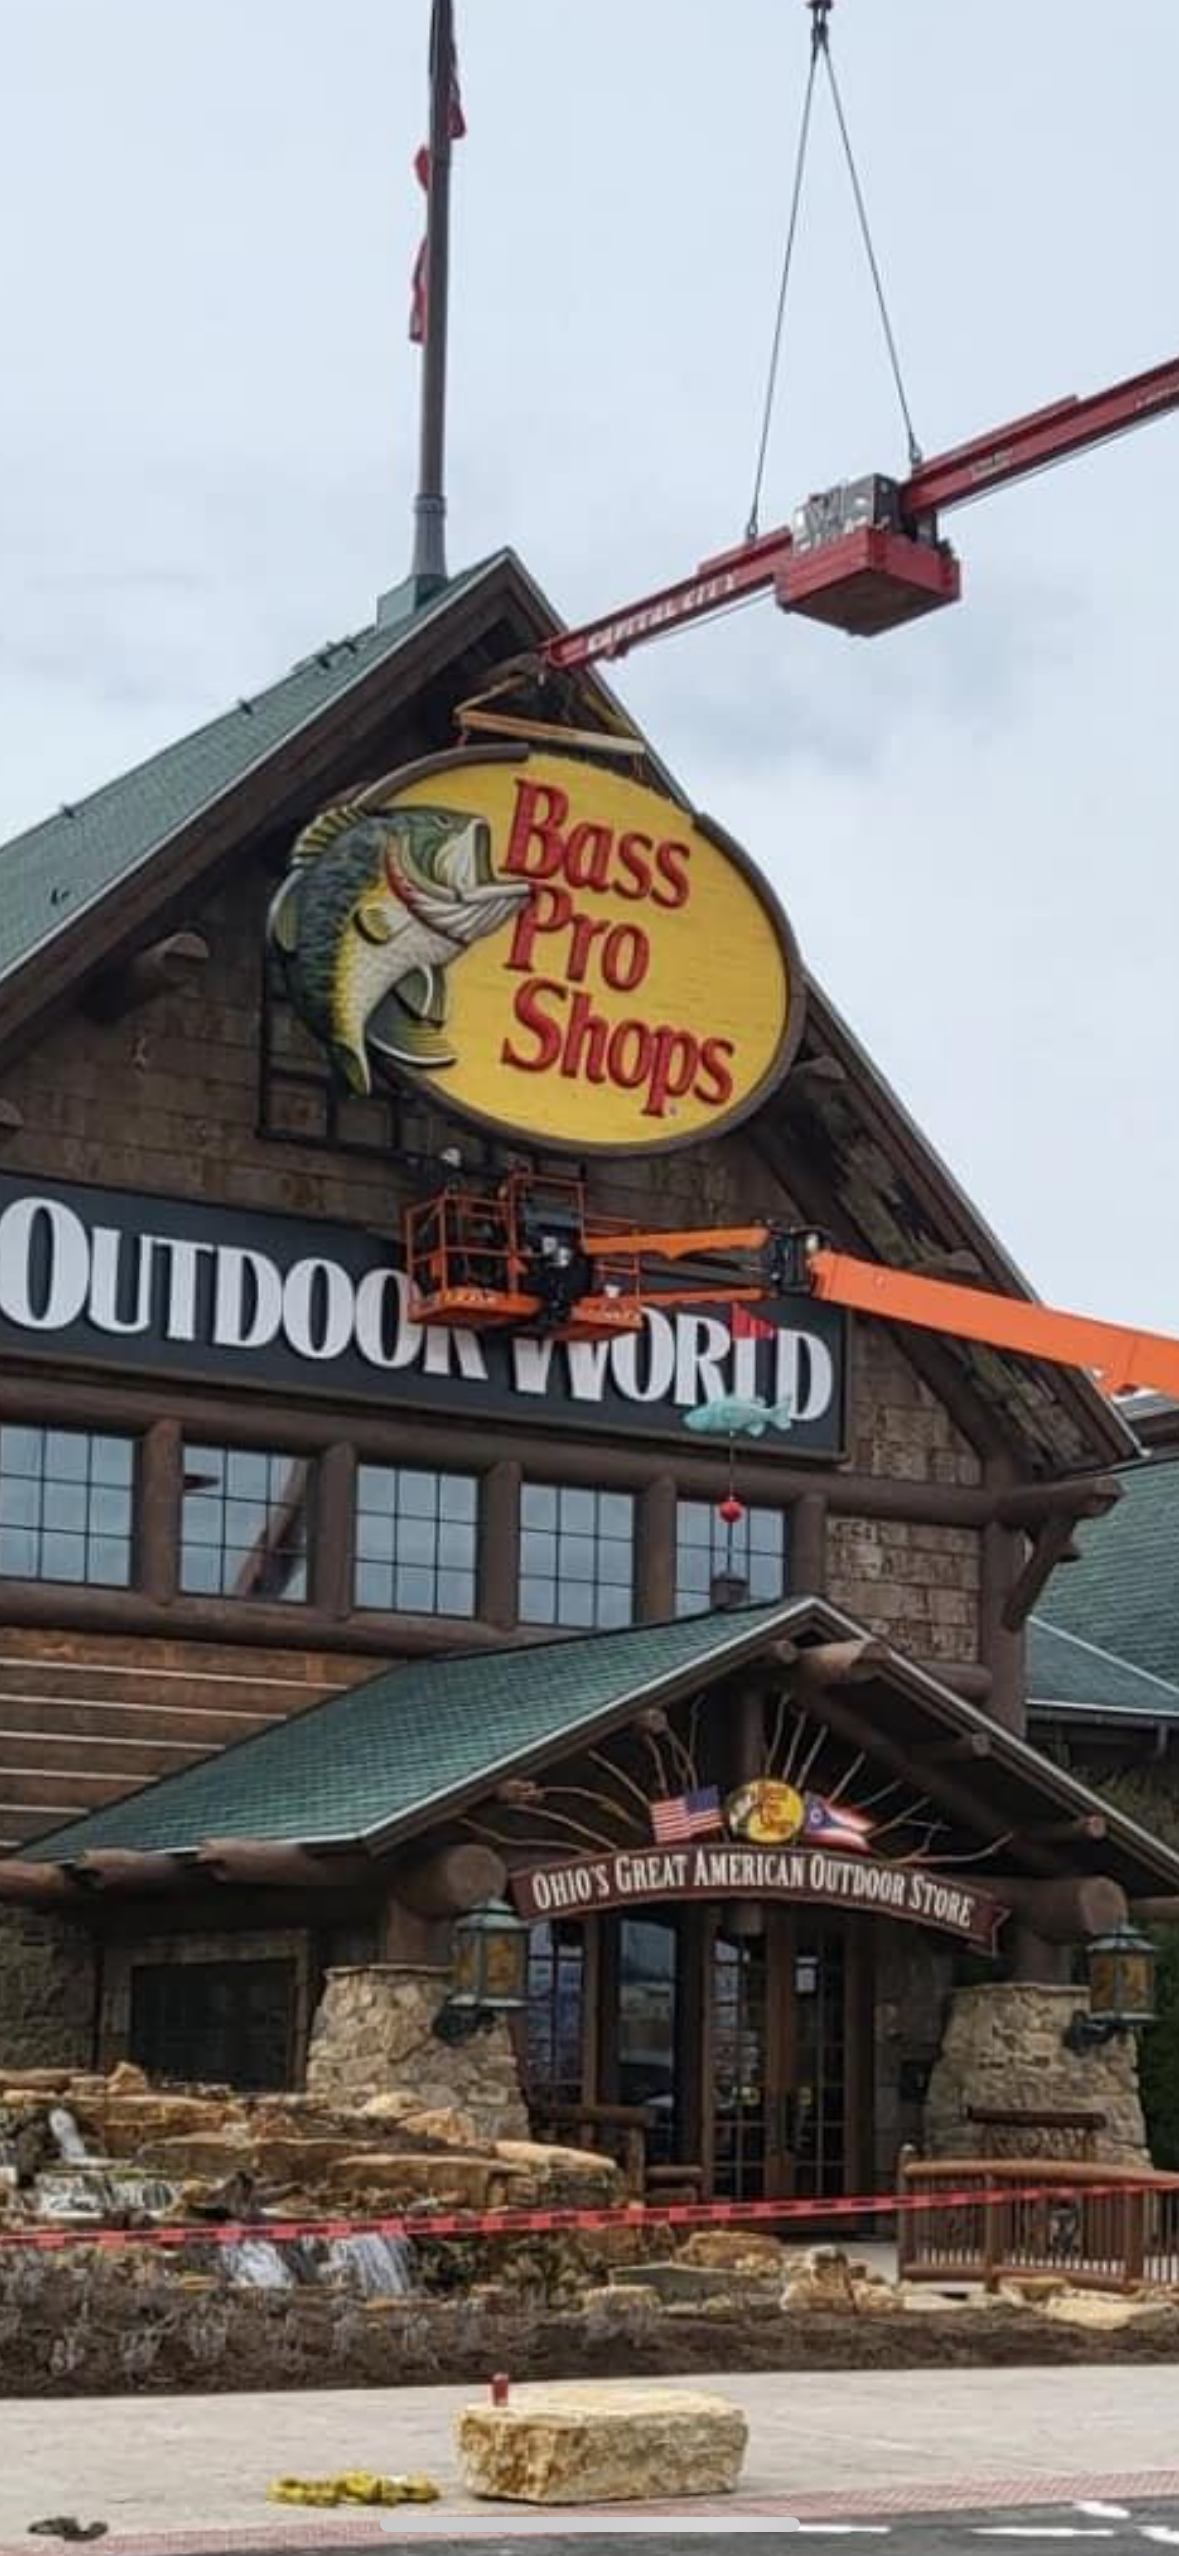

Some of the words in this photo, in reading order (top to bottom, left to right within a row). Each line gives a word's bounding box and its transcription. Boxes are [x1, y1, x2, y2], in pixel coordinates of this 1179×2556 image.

[498, 778, 691, 909] Bass
[503, 881, 651, 992] Pro
[500, 977, 735, 1119] Shops
[532, 1864, 610, 1910] OHIO'S
[615, 1854, 688, 1893] GREAT
[693, 1847, 805, 1887] AMERICAN
[810, 1854, 906, 1906] OUTDOOR
[909, 1874, 976, 1928] STORE
